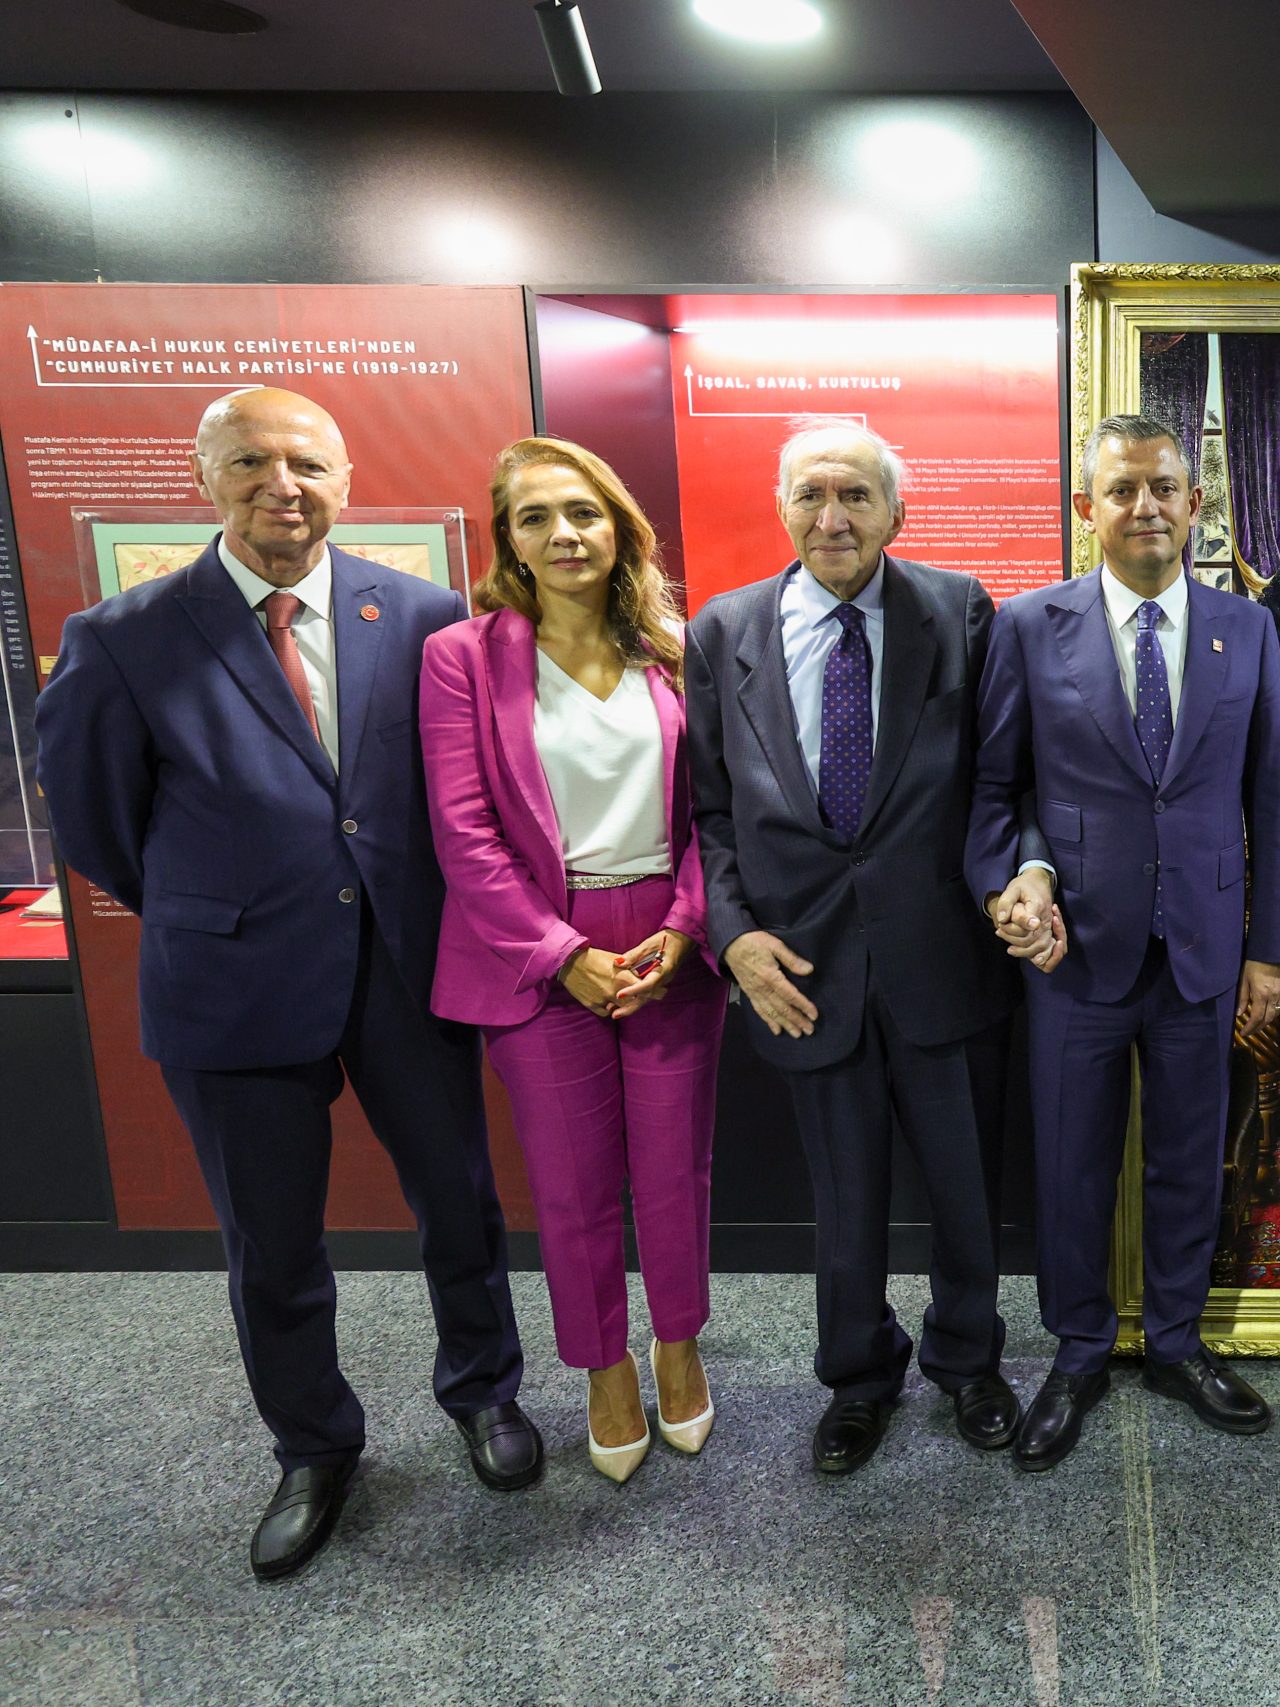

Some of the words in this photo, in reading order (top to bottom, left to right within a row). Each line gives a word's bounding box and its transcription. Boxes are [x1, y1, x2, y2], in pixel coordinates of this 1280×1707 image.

[165, 340, 227, 353] HUKUK
[183, 361, 231, 374] HALK
[353, 360, 459, 375] (1919-1927)
[698, 374, 750, 390] İŞGAL,
[756, 377, 812, 390] SAVAŞ,
[819, 377, 902, 391] KURTULUŞ
